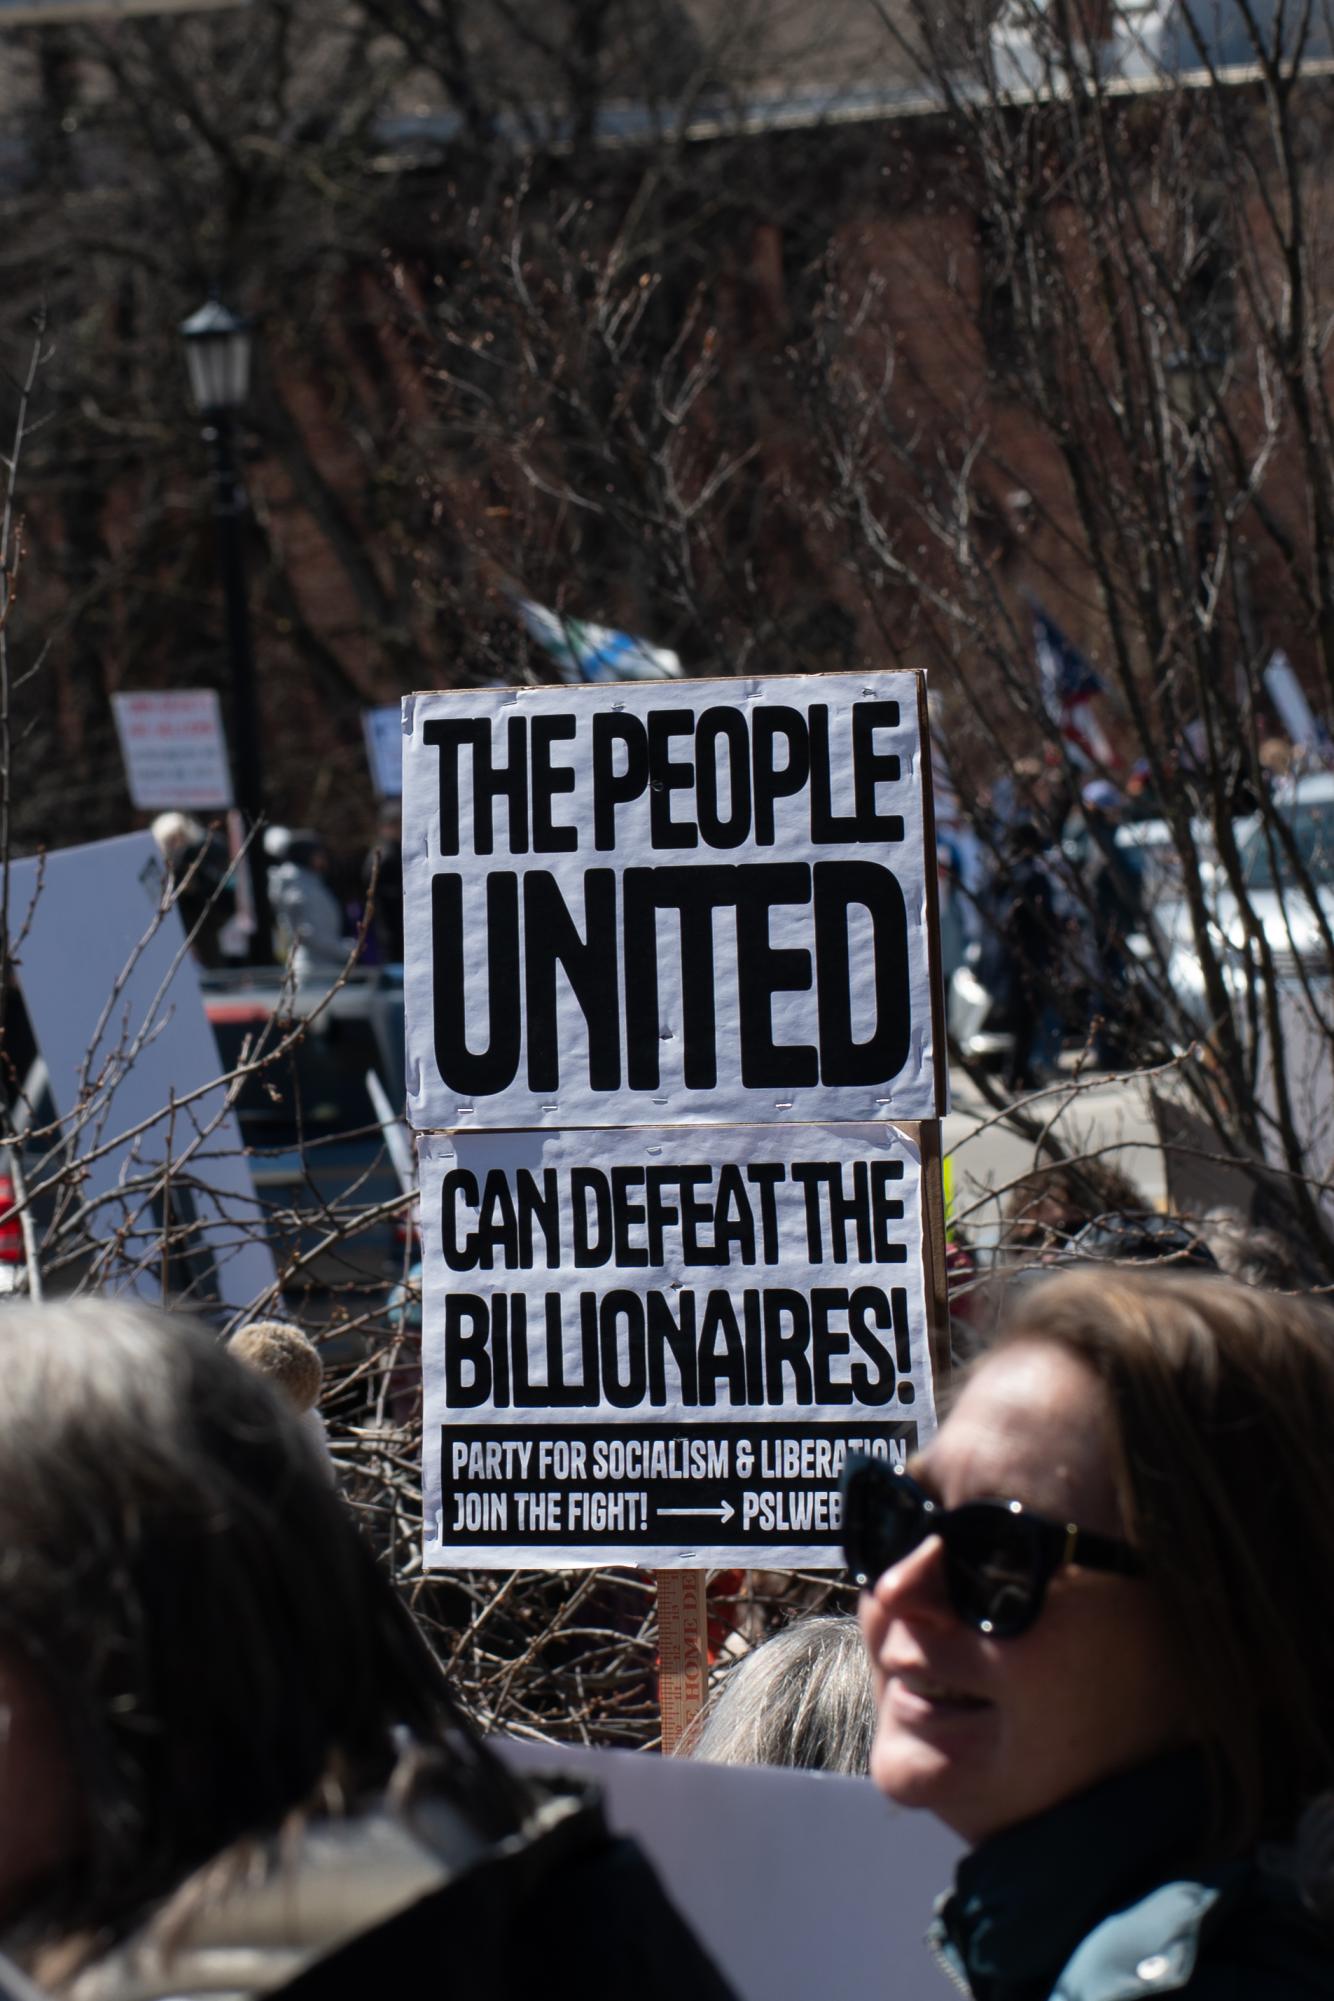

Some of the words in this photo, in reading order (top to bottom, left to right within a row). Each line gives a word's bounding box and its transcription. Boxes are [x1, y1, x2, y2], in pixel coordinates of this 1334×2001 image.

[423, 713, 579, 857] THE
[592, 700, 905, 852] PEOPLE
[431, 860, 911, 1096] UNITED
[441, 1167, 560, 1273] CAN
[571, 1163, 786, 1269] DEFEAT
[792, 1160, 908, 1264] THE
[444, 1286, 915, 1409] BILLIONAIRES!
[452, 1441, 533, 1480] PARTY
[539, 1441, 587, 1480] FOR
[592, 1440, 729, 1480] SOCIALISM
[735, 1439, 755, 1479] &
[452, 1492, 508, 1532] JOIN
[513, 1492, 562, 1531] THE
[568, 1491, 648, 1531] FIGHT!
[682, 1568, 698, 1610] DE
[683, 1617, 700, 1701] HOME
